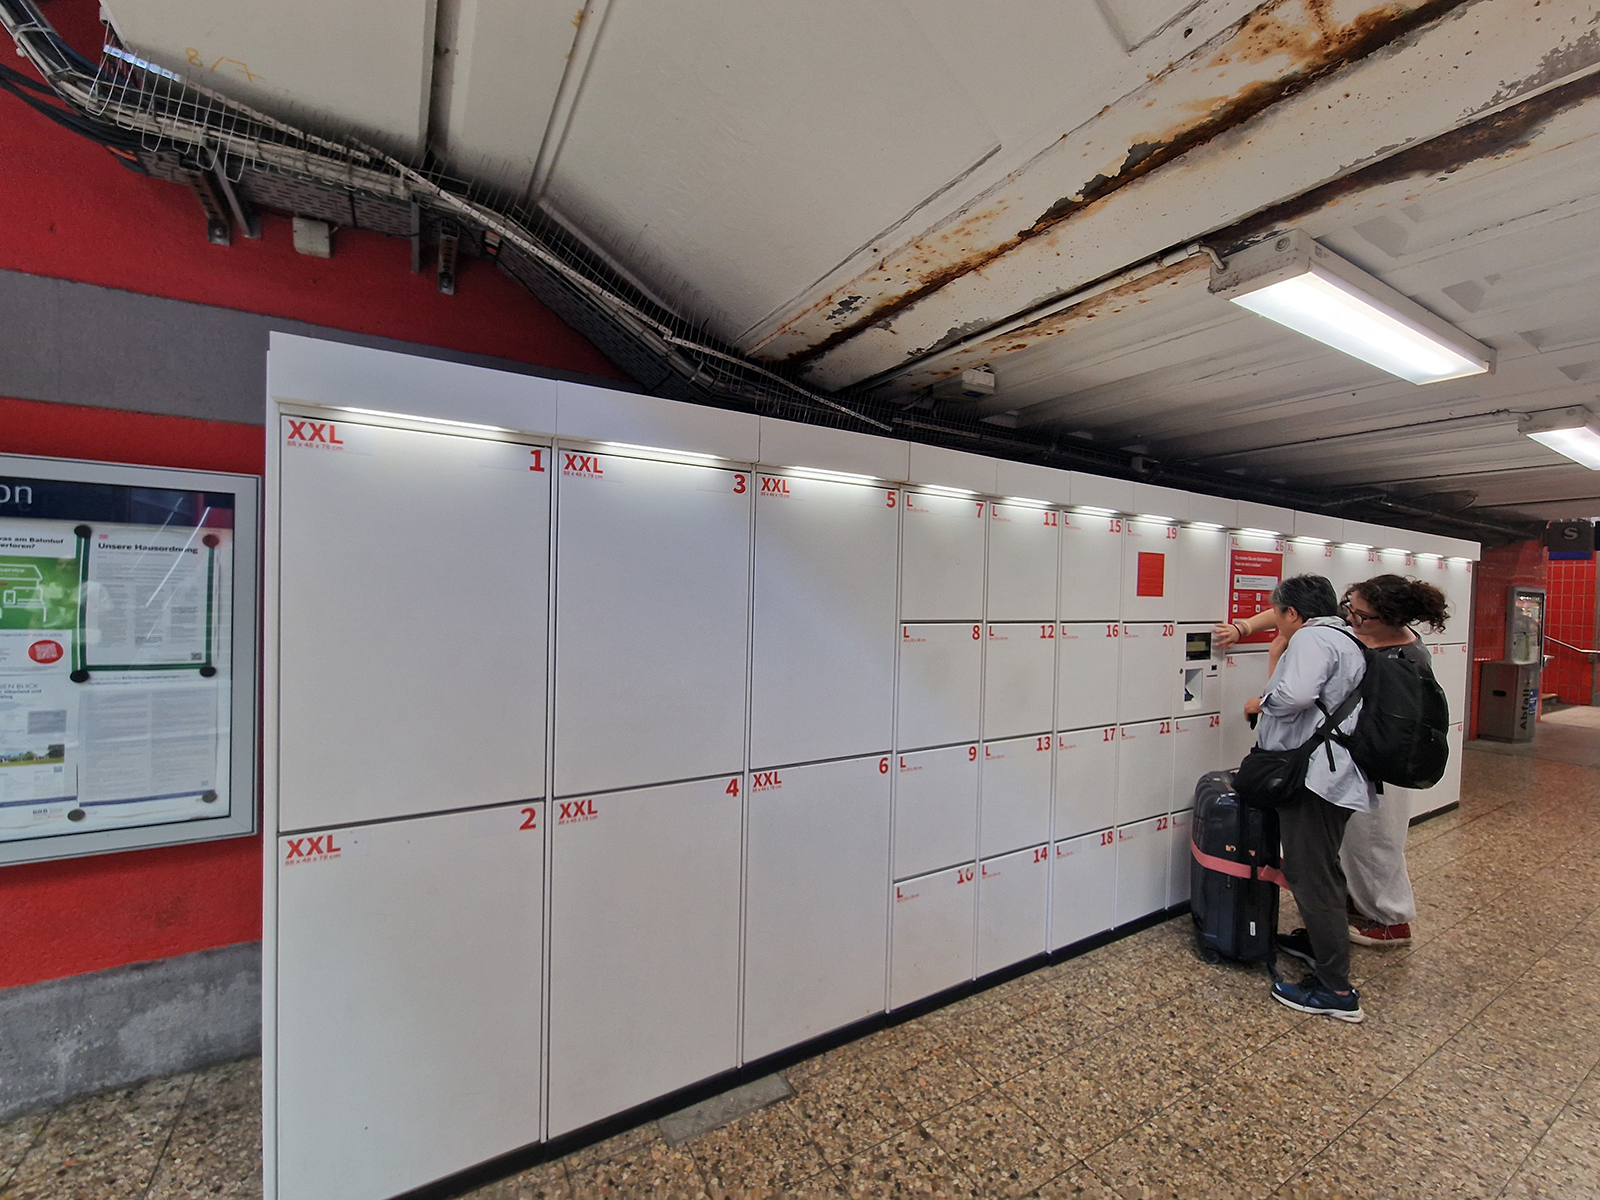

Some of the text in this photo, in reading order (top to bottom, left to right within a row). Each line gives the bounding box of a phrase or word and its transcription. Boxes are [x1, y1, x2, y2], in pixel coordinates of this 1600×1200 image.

[288, 420, 344, 444] XXL
[529, 449, 545, 472] 1
[564, 453, 604, 474] XXL
[733, 474, 746, 494] 3
[761, 477, 790, 494] XXL
[886, 491, 897, 508] 5
[906, 495, 913, 507] L
[976, 502, 984, 518] 7
[992, 505, 998, 517] L
[1043, 511, 1058, 527] 11
[1065, 515, 1070, 525] L
[1109, 520, 1122, 533] 15
[1127, 523, 1132, 533] L
[1166, 527, 1177, 540] 19
[1564, 527, 1579, 540] S
[98, 542, 132, 550] Unsere
[134, 544, 198, 555] Hausordnung
[1275, 540, 1284, 552] 26
[903, 626, 910, 638] L
[972, 625, 980, 640] 8
[989, 626, 994, 637] L
[1040, 624, 1055, 639] 12
[1062, 626, 1067, 636] L
[1106, 624, 1119, 638] 16
[1124, 626, 1129, 635] L
[1162, 624, 1174, 637] 20
[1519, 689, 1530, 730] Abfall
[1176, 721, 1180, 731] L
[1210, 715, 1220, 728] 24
[1103, 728, 1116, 742] 17
[1121, 728, 1126, 738] L
[1160, 722, 1171, 735] 21
[1037, 736, 1051, 752] 13
[1059, 737, 1065, 748] L
[969, 746, 977, 762] 9
[986, 746, 991, 757] L
[879, 757, 889, 774] 6
[900, 757, 906, 769] L
[753, 771, 782, 788] XXL
[726, 778, 740, 797] 4
[560, 799, 598, 820] XXL
[519, 807, 536, 831] 2
[1157, 817, 1168, 831] 22
[1173, 816, 1177, 825] L
[1101, 830, 1113, 847] 18
[1119, 830, 1123, 839] L
[286, 834, 342, 859] XXL
[1057, 846, 1061, 856] L
[1033, 846, 1048, 863] 14
[982, 865, 987, 876] L
[897, 887, 903, 899] L
